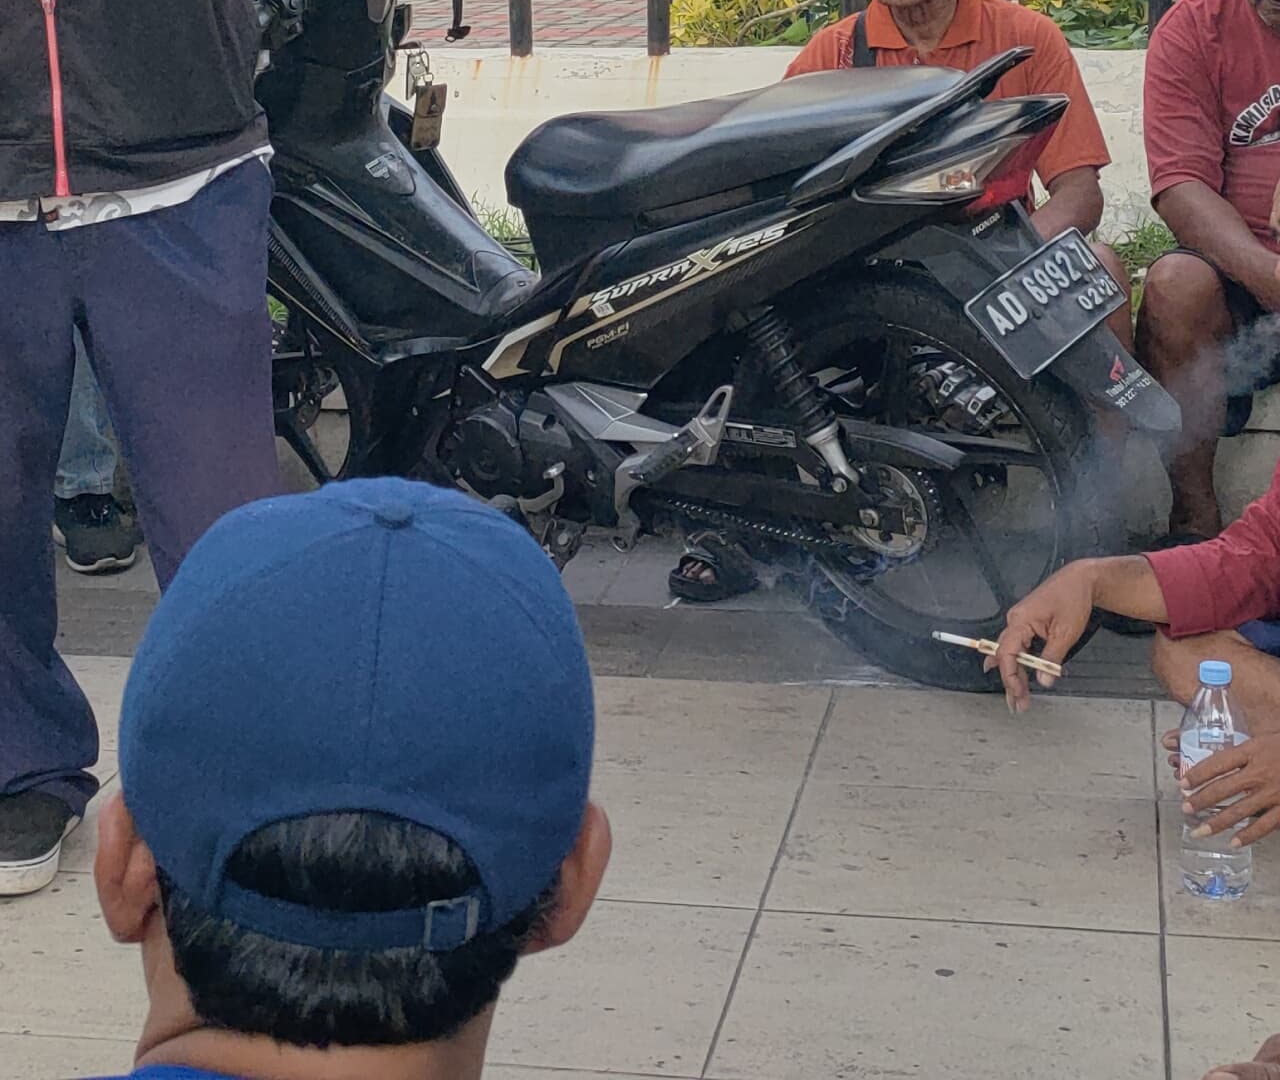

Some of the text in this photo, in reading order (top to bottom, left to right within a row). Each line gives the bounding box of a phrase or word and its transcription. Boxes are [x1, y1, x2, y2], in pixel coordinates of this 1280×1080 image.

[1230, 103, 1268, 145] KAMI
[972, 212, 1001, 236] HONDA
[986, 291, 1028, 337] AD
[1022, 251, 1082, 305] 6992
